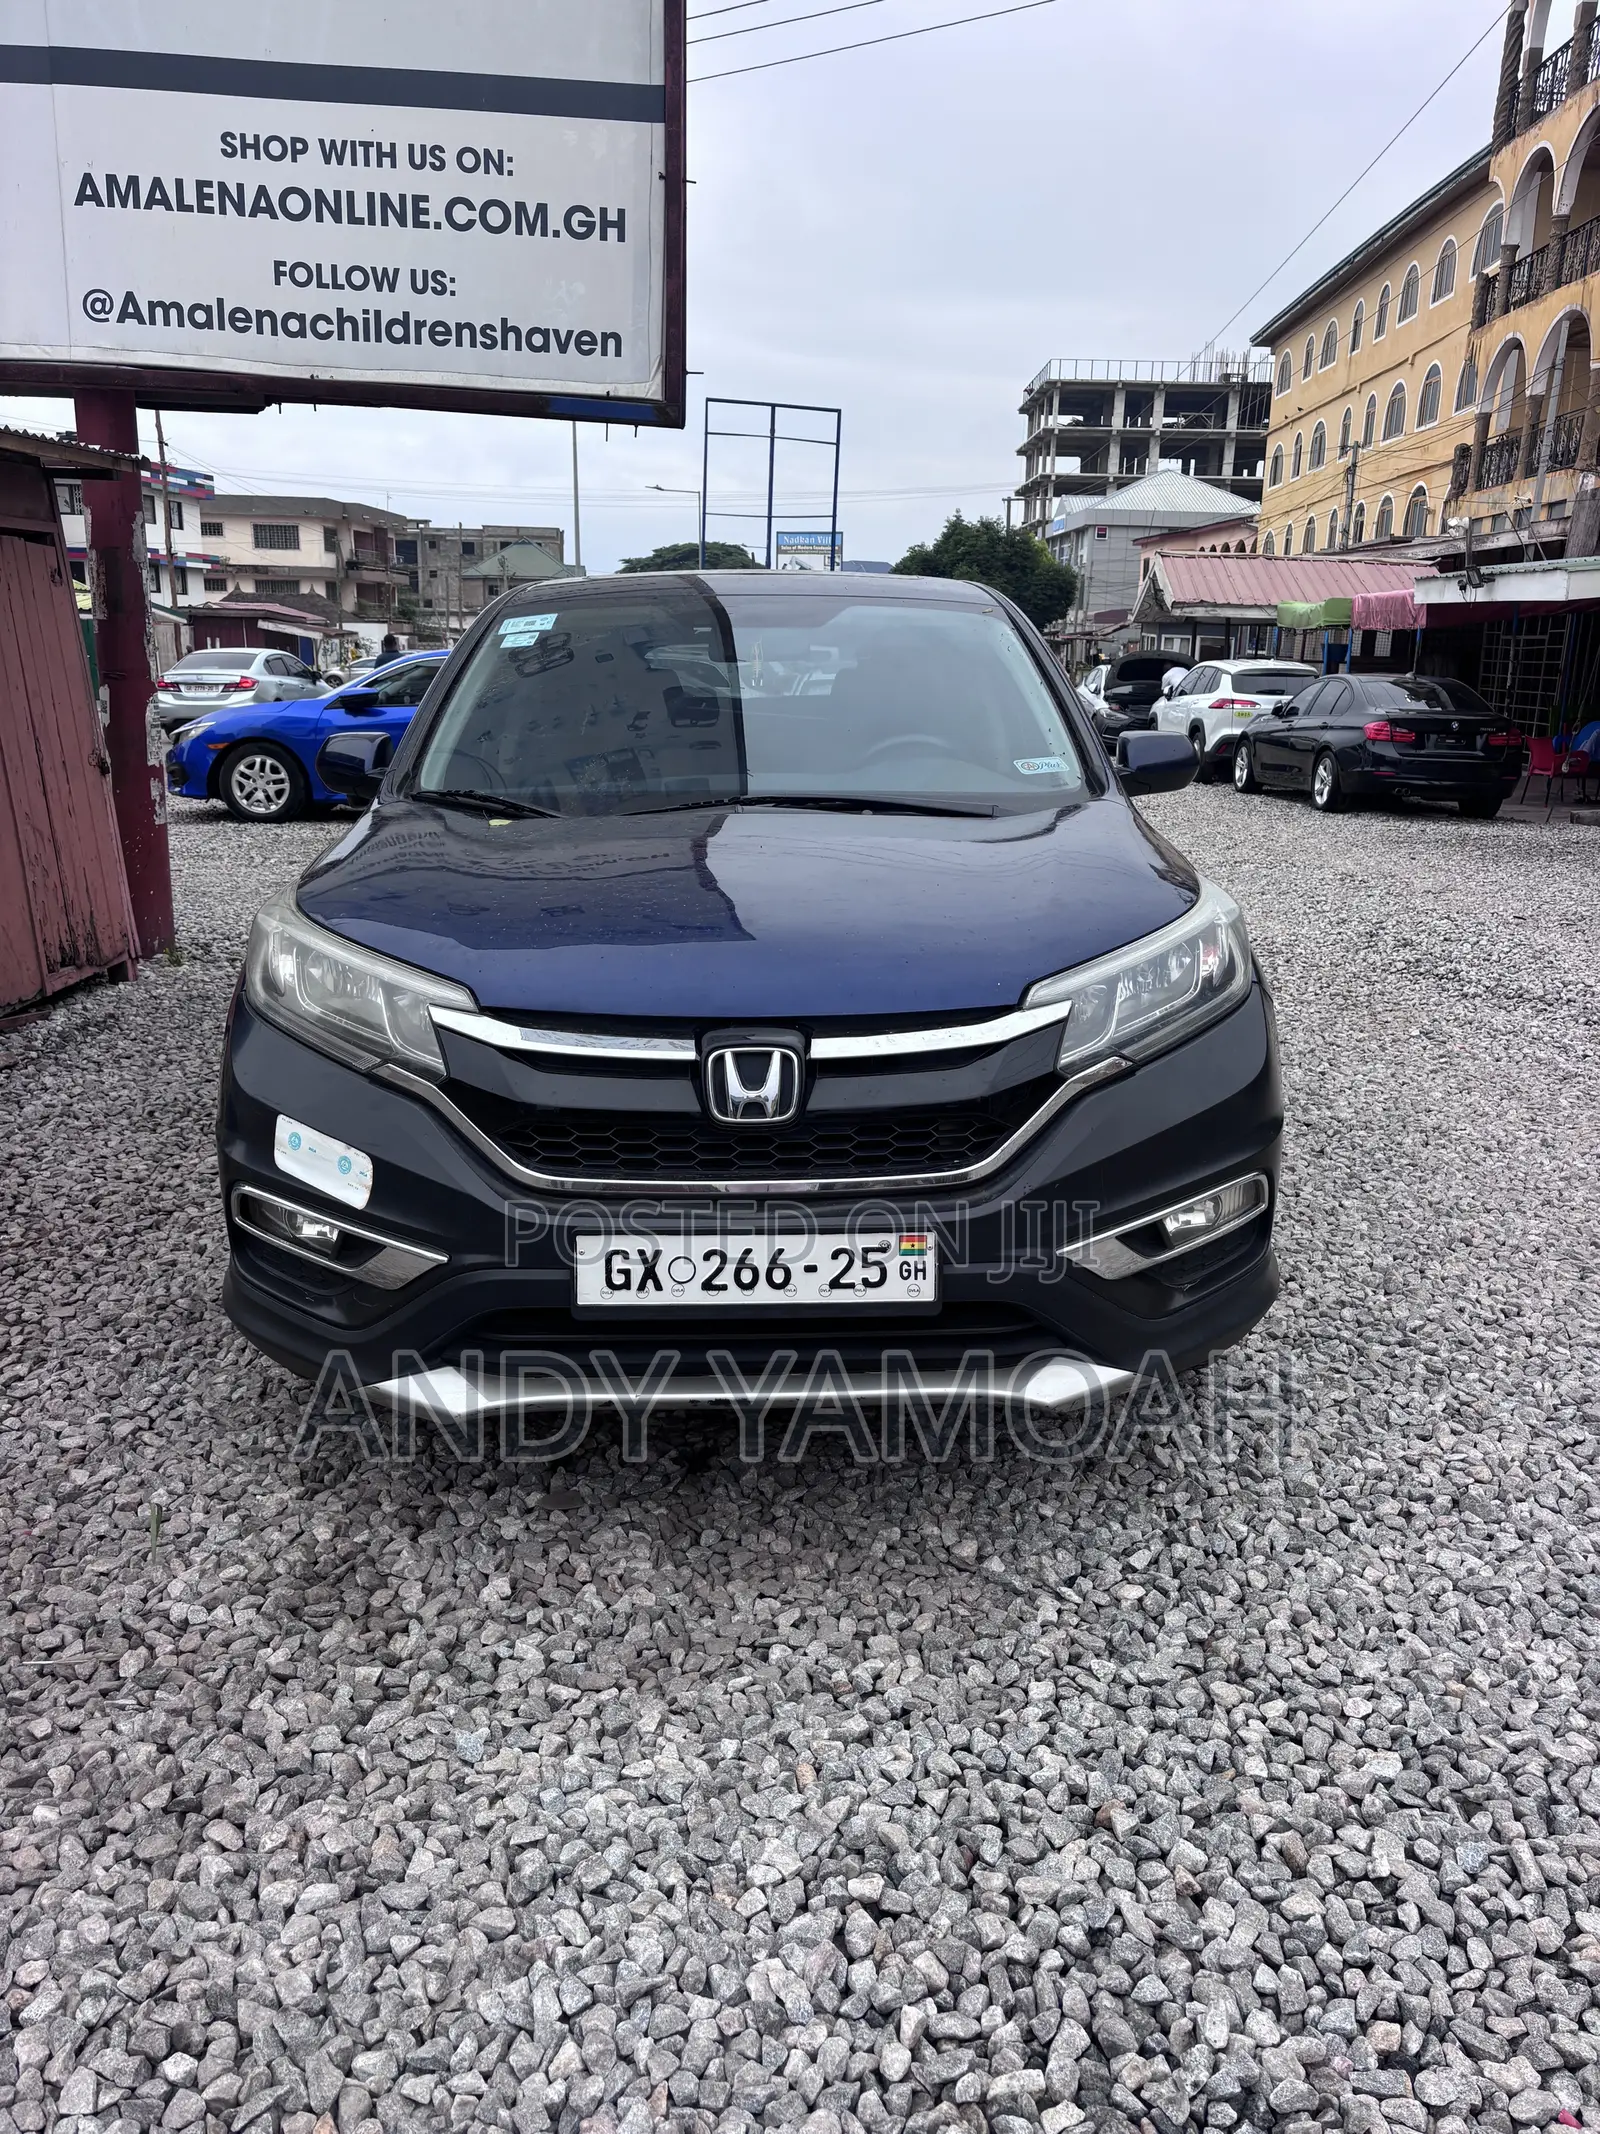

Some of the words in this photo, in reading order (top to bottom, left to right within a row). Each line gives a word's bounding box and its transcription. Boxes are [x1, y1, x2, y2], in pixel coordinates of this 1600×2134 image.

[220, 131, 309, 164] SHOP
[317, 137, 397, 170] WITH
[407, 143, 447, 172] US
[455, 146, 514, 177] ON:
[73, 172, 626, 243] AMALENAONLINE.COM.GH
[273, 259, 401, 295] FOLLOW
[409, 268, 457, 297] US:
[82, 287, 623, 358] @Amalenachildrenshaven
[604, 1248, 664, 1292] GX
[899, 1260, 927, 1281] GH
